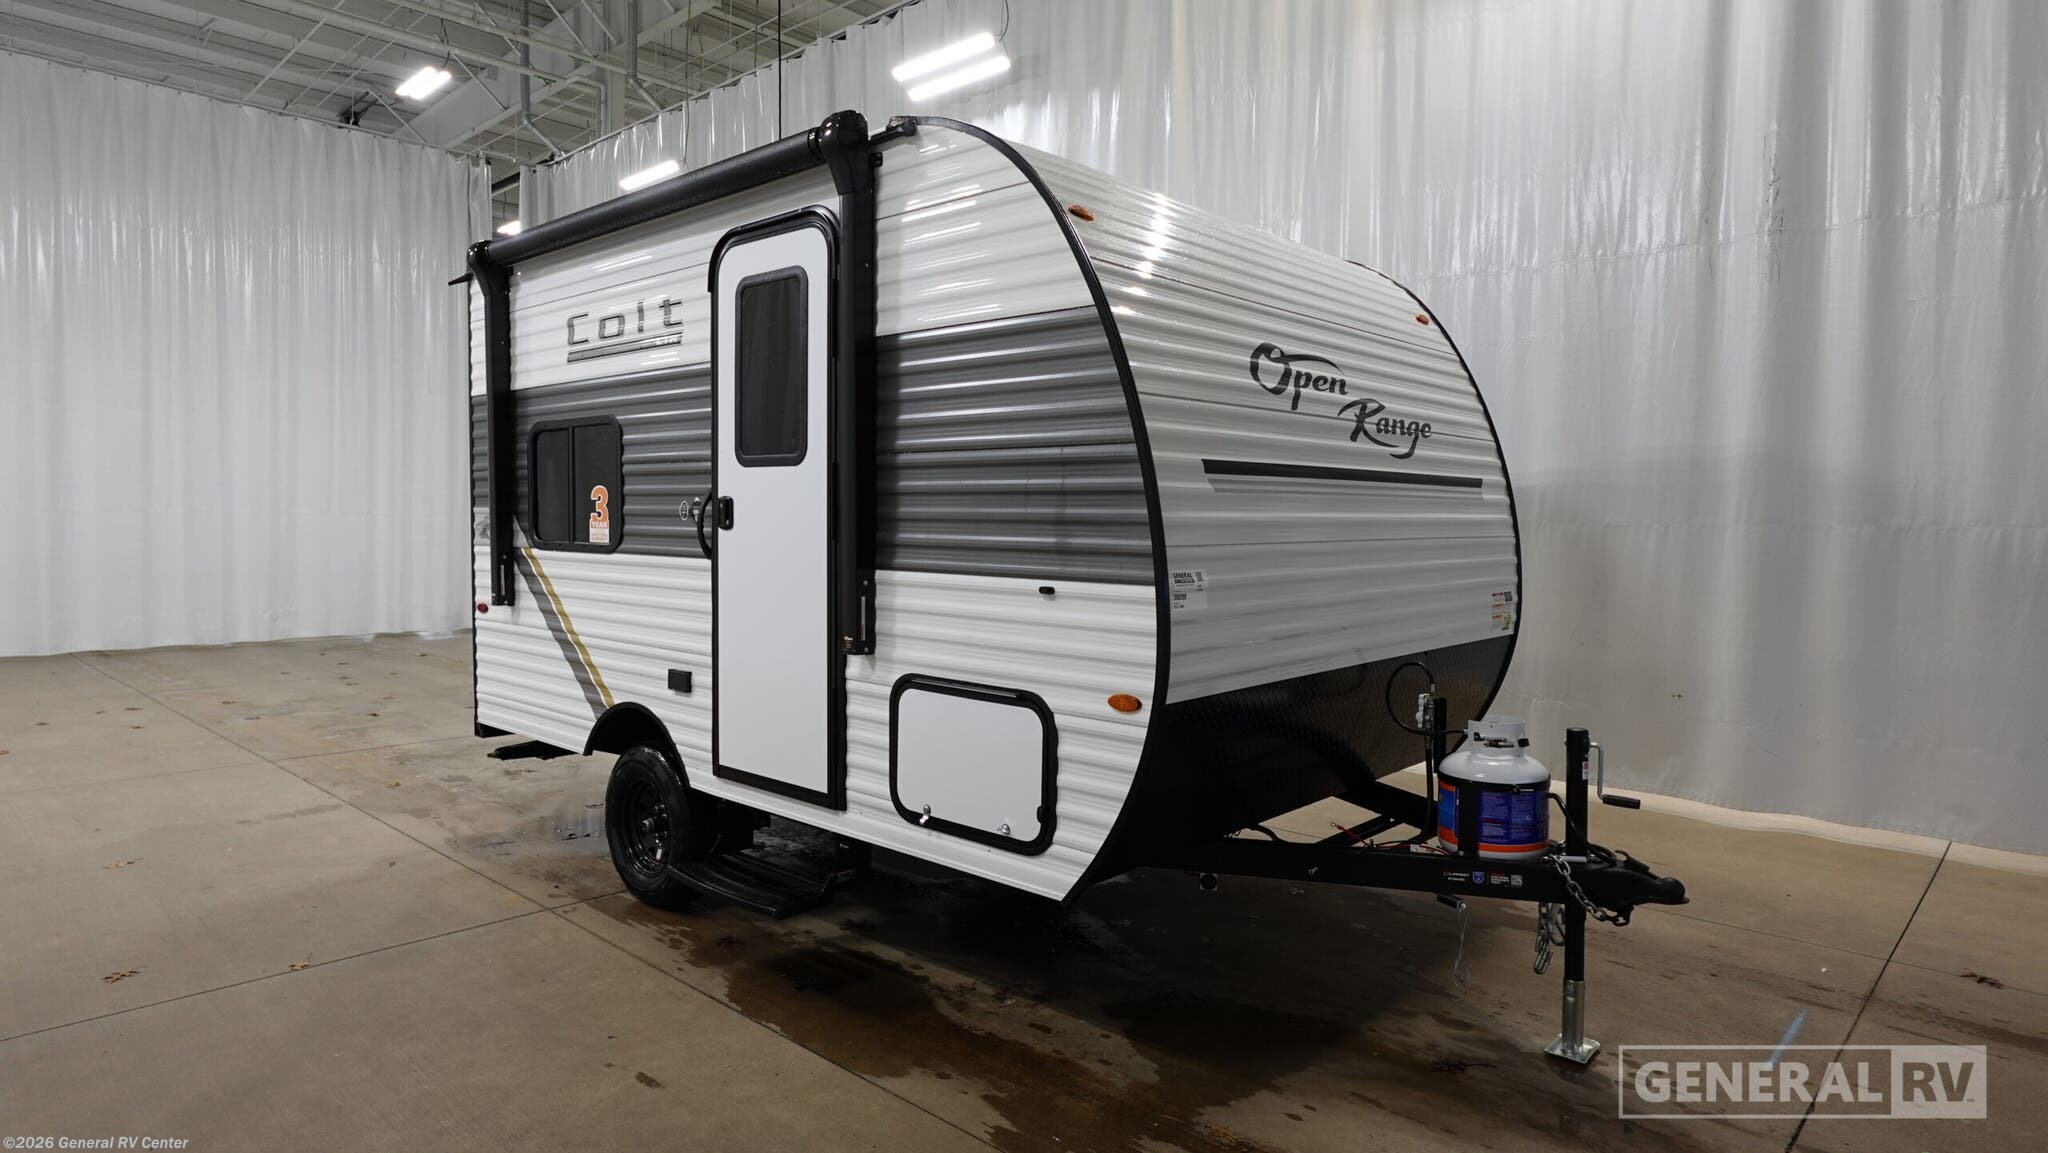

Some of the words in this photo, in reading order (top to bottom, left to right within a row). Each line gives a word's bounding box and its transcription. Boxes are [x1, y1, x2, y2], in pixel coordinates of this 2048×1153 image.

[567, 298, 683, 346] Colt
[1250, 341, 1349, 411] Open
[1337, 397, 1433, 460] Range
[590, 485, 609, 522] 3
